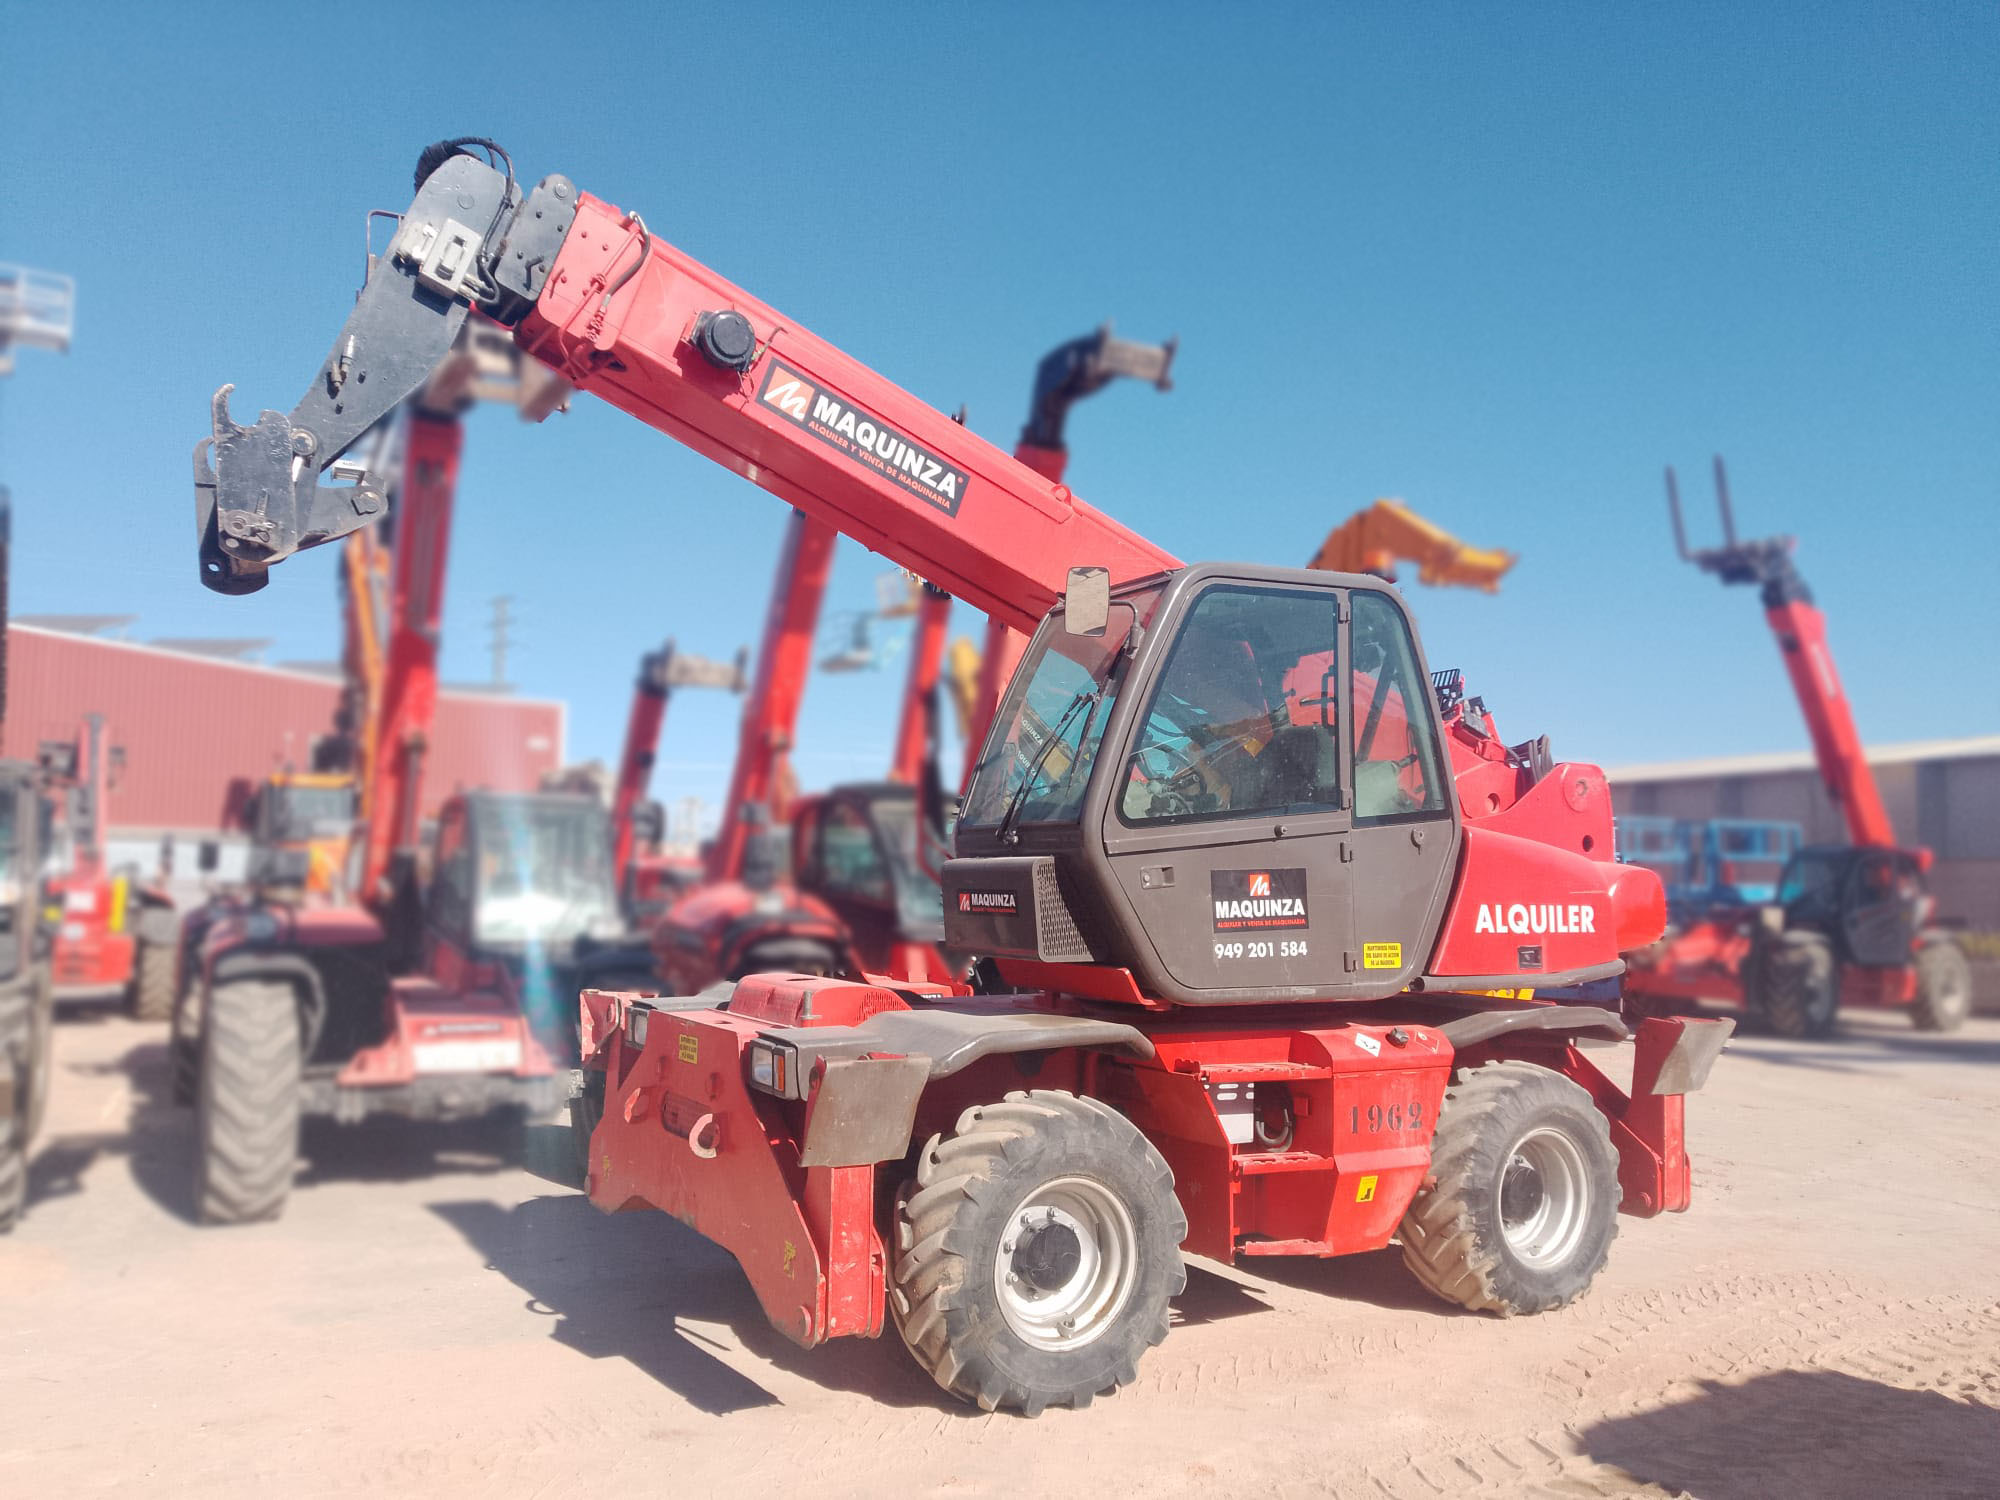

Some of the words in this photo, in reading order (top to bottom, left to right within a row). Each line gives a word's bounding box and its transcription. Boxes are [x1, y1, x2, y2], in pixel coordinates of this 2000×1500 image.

[813, 394, 955, 499] MAQUINZA
[808, 420, 849, 449] ALQUILER
[850, 442, 858, 453] Y
[858, 448, 885, 471] VENTA
[886, 465, 898, 478] DE
[898, 472, 951, 510] MAQUINARIA
[971, 893, 1016, 907] MAQUINZA
[1215, 899, 1305, 919] MAQUINZA
[1475, 903, 1596, 935] ALQUILER
[1214, 942, 1243, 959] 949
[1247, 941, 1274, 958] 201
[1280, 940, 1308, 957] 584
[1351, 1101, 1423, 1135] 1962
